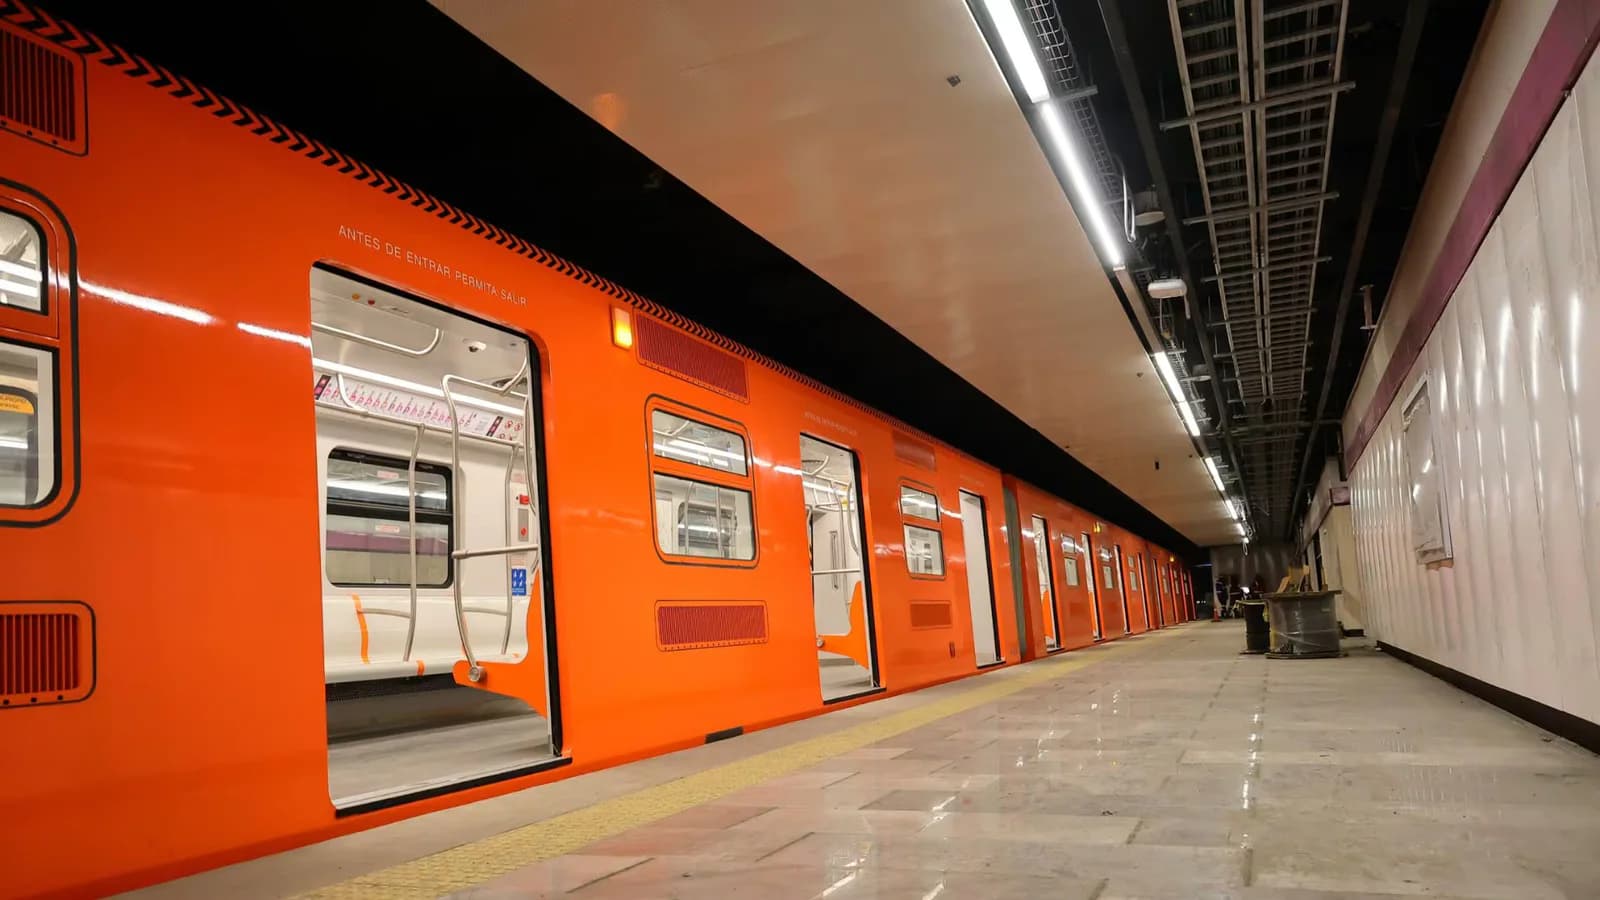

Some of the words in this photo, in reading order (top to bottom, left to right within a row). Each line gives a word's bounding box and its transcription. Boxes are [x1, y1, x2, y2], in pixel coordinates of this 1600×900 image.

[338, 225, 381, 251] ANTES
[385, 242, 402, 259] DE
[406, 251, 452, 279] ENTRAR
[455, 270, 498, 297] PERMITA
[500, 288, 528, 307] SALIR
